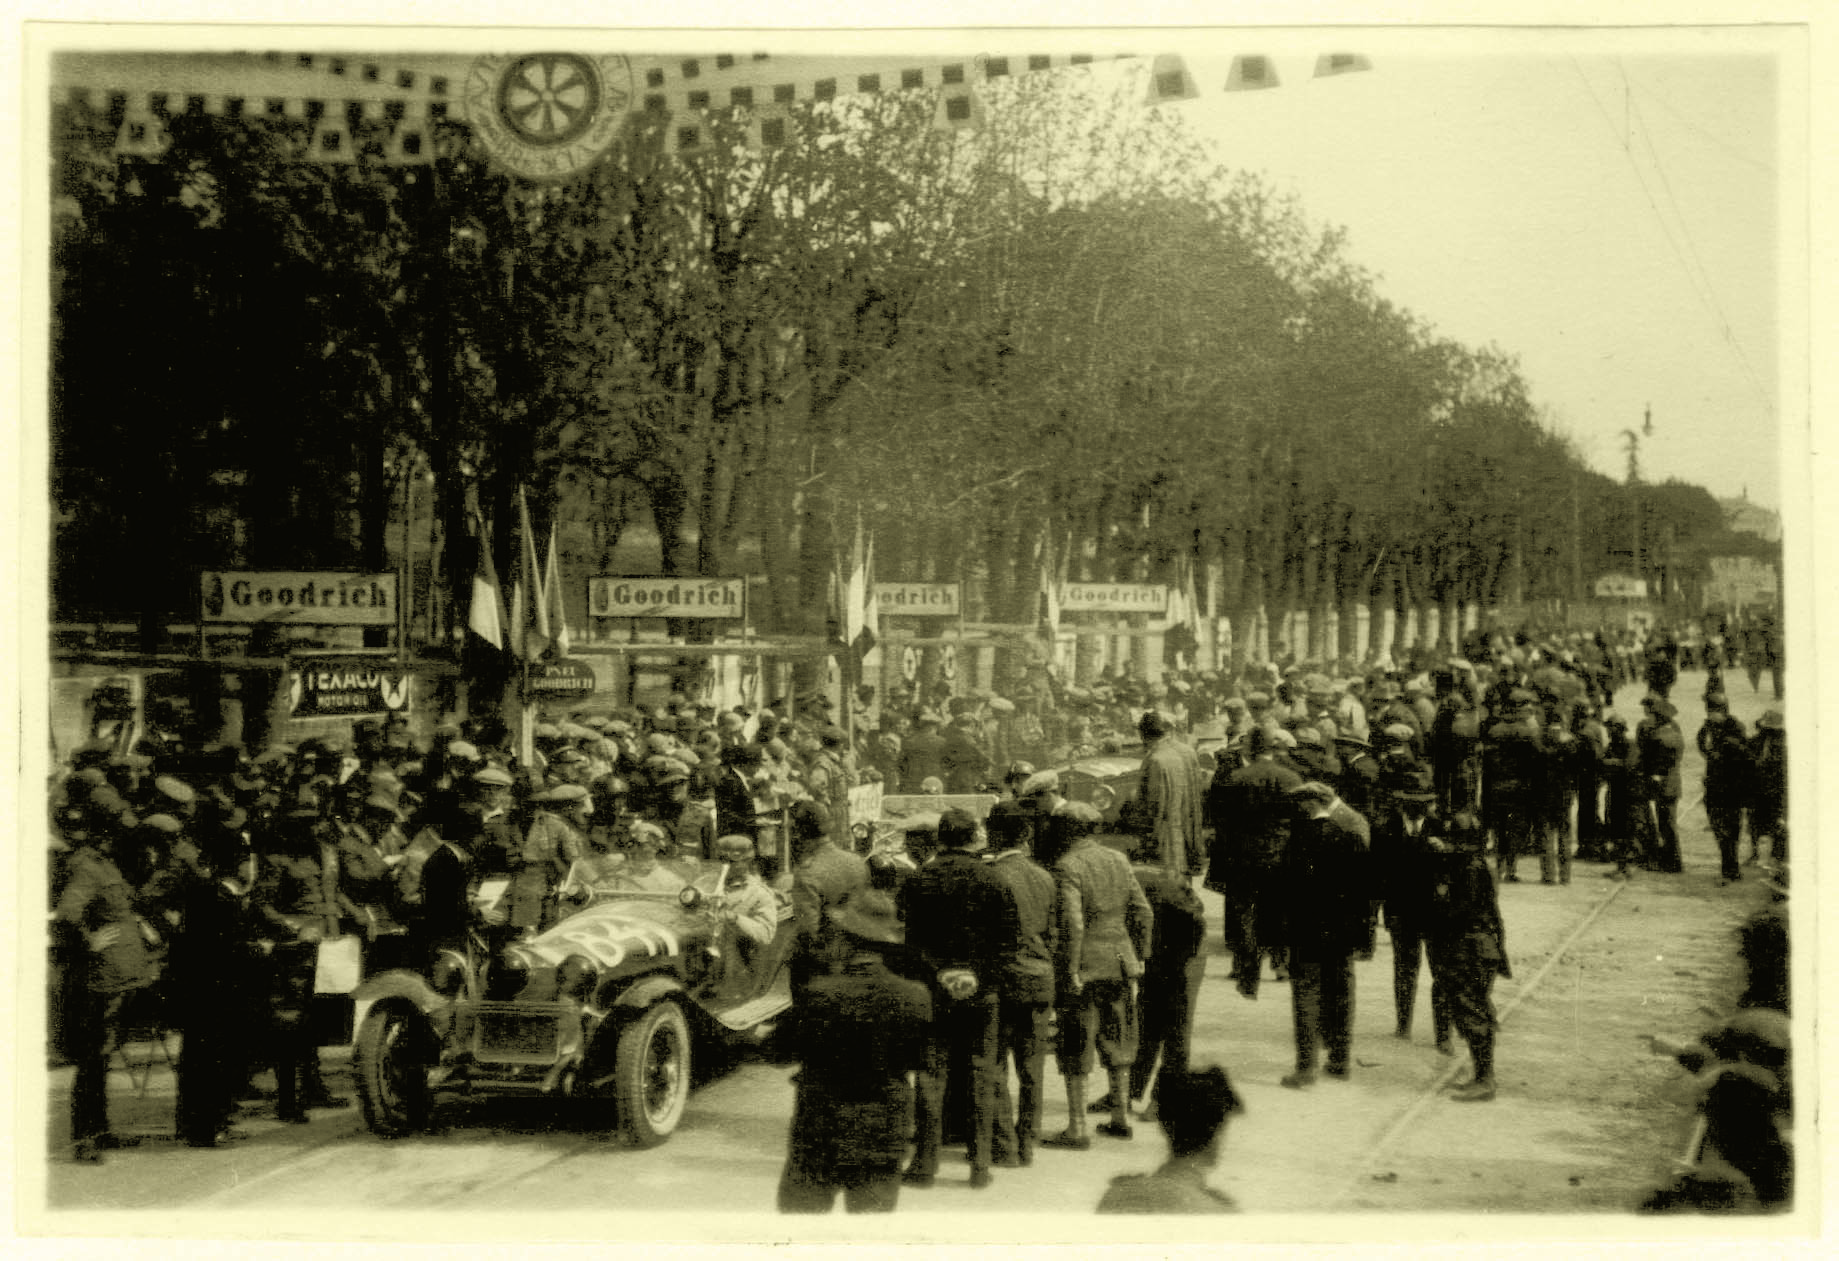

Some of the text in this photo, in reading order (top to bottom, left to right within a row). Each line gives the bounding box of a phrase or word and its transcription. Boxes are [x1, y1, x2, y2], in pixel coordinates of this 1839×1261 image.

[230, 579, 387, 608] Goodrich
[613, 583, 737, 606] Goodrich
[876, 587, 953, 605] odrich
[1069, 586, 1162, 603] Goodrich
